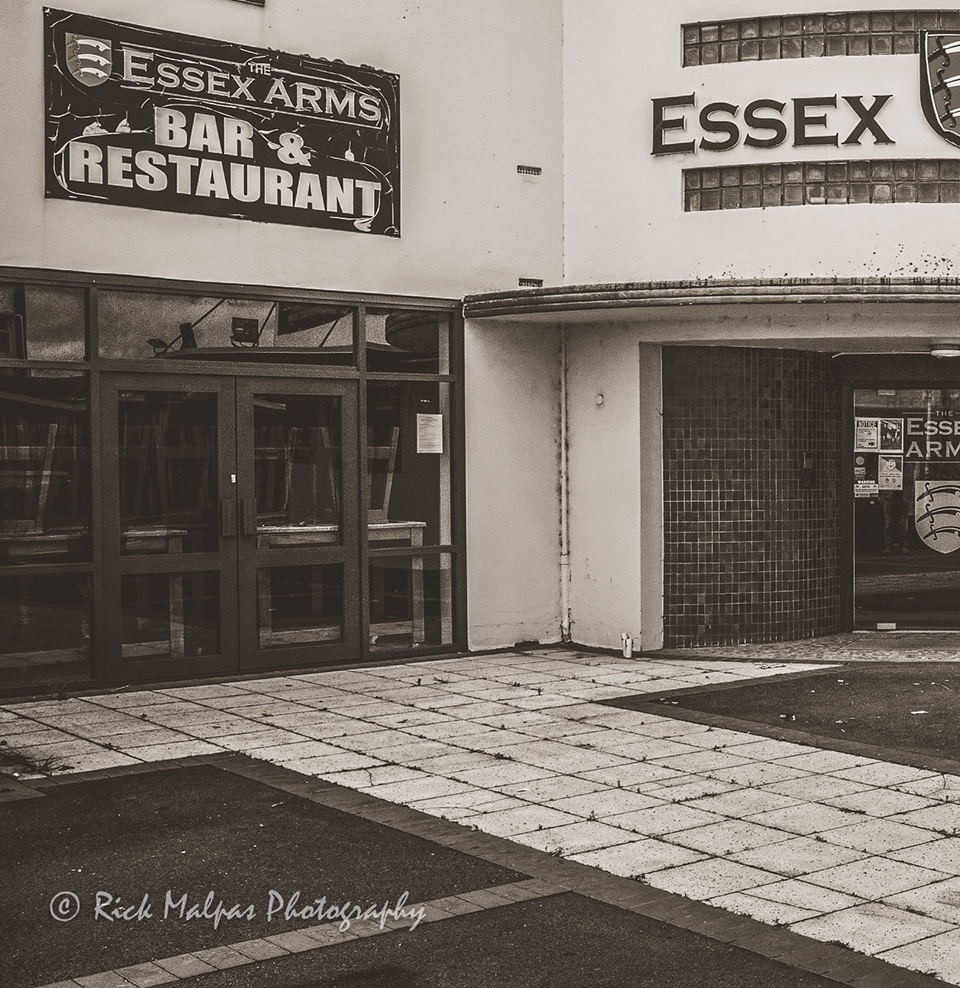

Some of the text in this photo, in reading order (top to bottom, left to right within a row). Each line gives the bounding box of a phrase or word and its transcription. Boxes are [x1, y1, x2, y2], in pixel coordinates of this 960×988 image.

[123, 48, 382, 122] ESSEX ARMS
[249, 62, 271, 76] THE
[154, 106, 311, 166] BAR &
[650, 92, 896, 156] ESSEX
[68, 141, 382, 216] RESTAURANT
